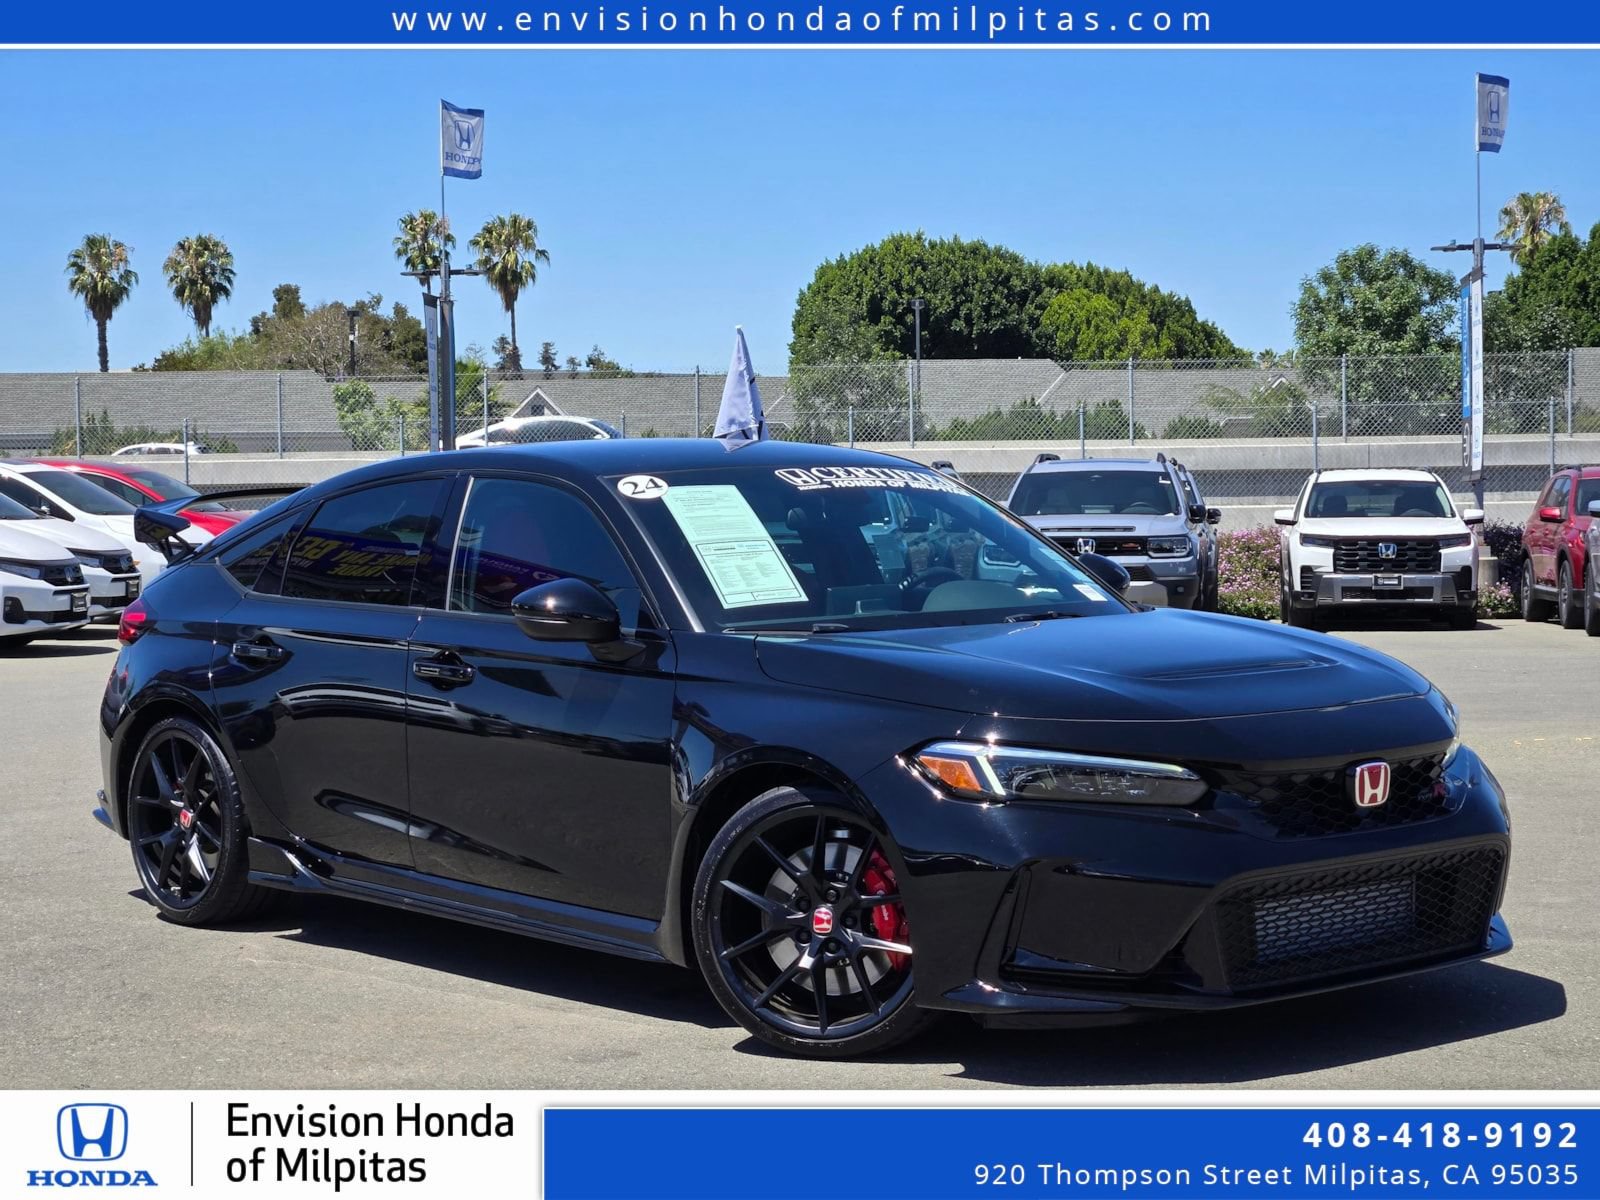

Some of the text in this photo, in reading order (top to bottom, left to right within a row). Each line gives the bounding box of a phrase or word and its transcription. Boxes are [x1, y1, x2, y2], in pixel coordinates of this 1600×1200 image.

[1481, 126, 1505, 138] HON
[622, 478, 663, 495] 24
[832, 479, 886, 488] HONDA
[887, 480, 906, 488] OF
